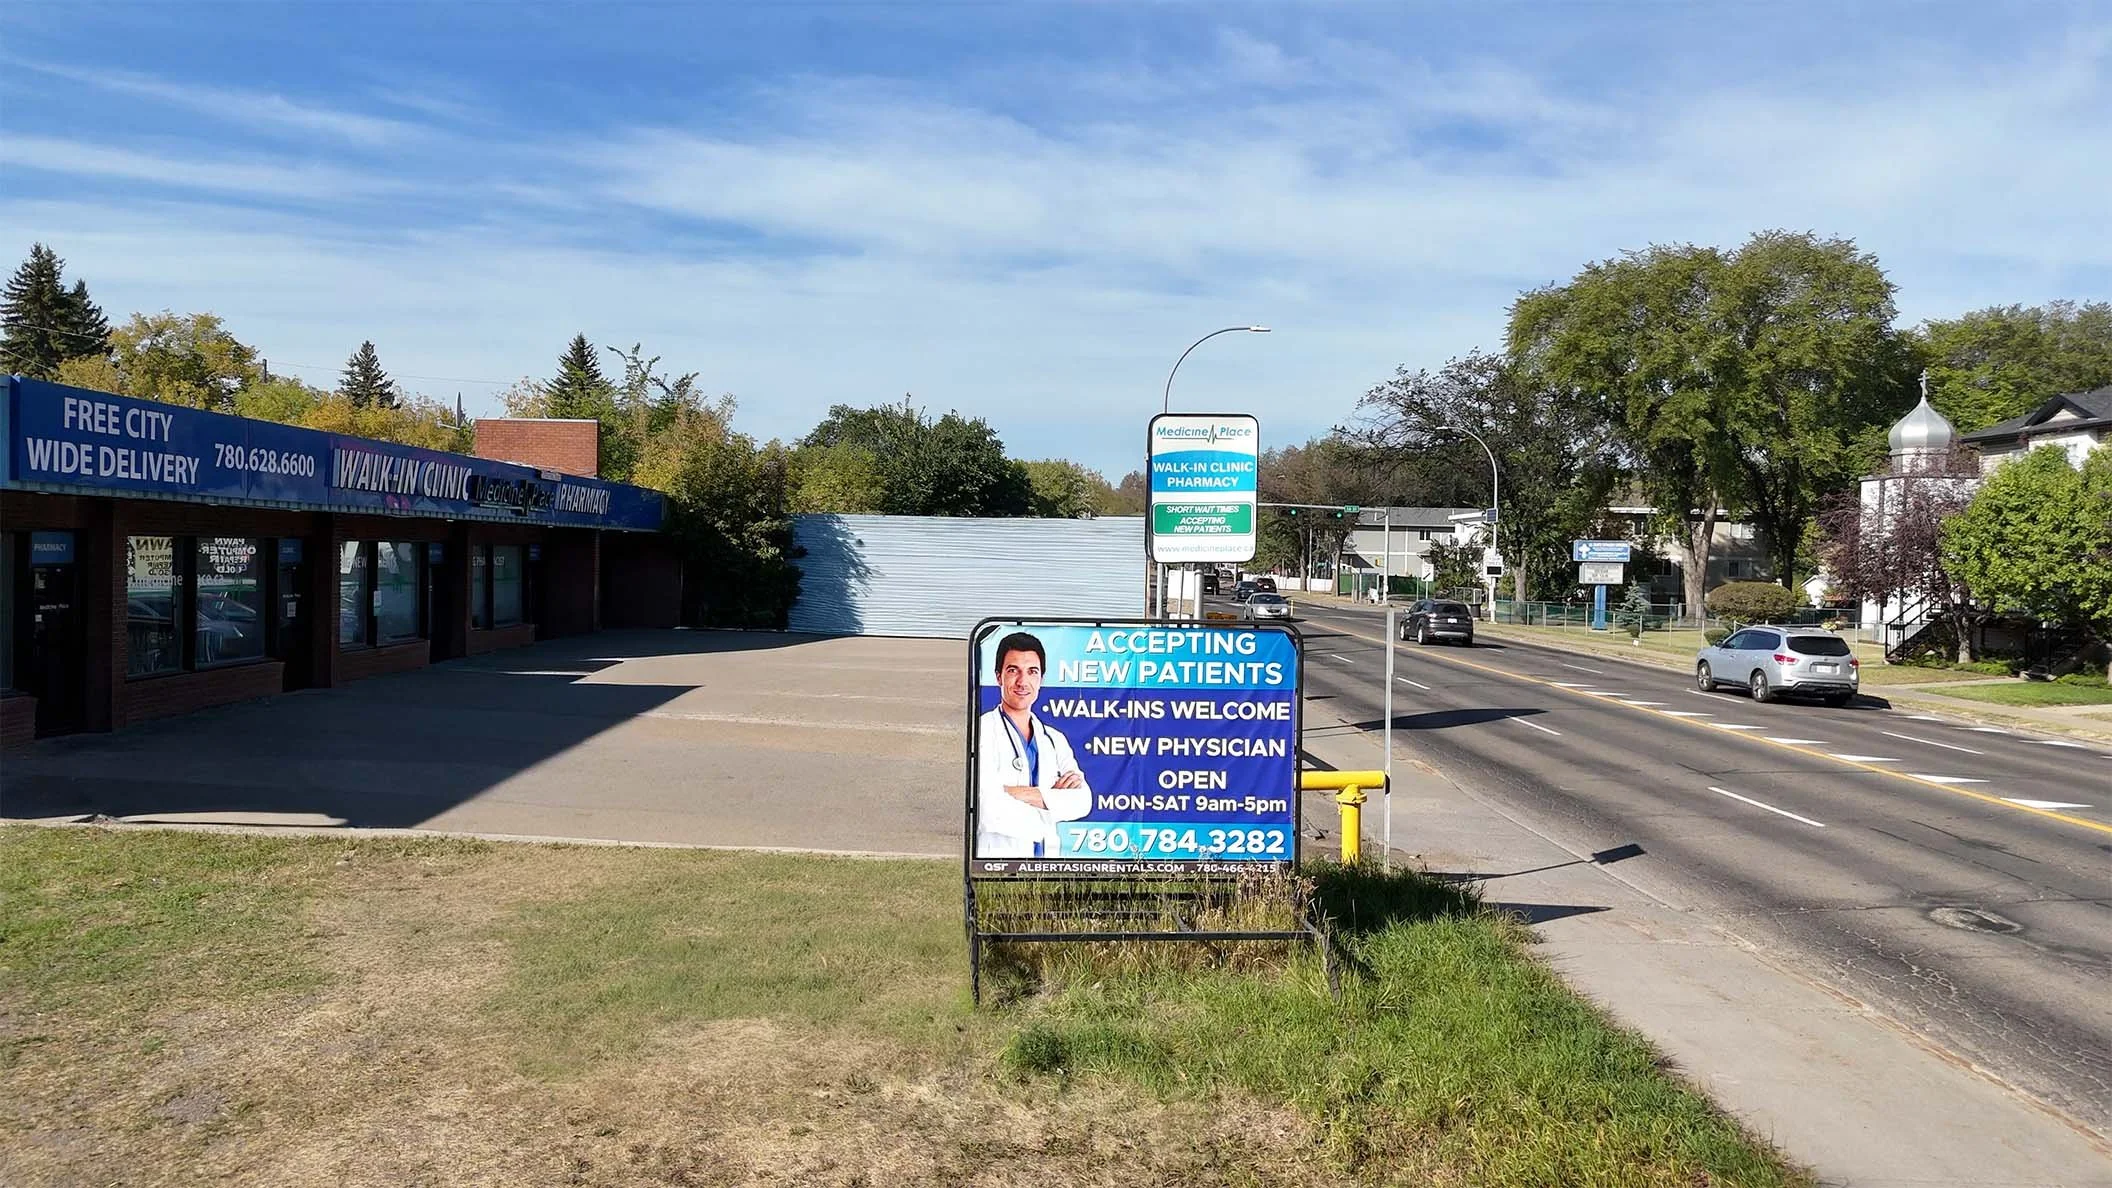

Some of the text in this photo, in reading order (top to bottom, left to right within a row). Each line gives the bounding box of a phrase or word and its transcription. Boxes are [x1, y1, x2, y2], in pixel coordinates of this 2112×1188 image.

[64, 397, 173, 442] FREE CITY
[1156, 426, 1252, 437] Medicine Place
[27, 437, 200, 485] WIDE DELIVERY
[214, 443, 315, 477] 780.628.6600
[1153, 461, 1254, 473] WALK-IN CLINIC
[334, 448, 473, 501] WALK-IN CLINIC
[1167, 477, 1239, 488] PHARMACY
[475, 476, 524, 505] Medicine
[558, 483, 611, 514] PHARMACY
[1166, 505, 1240, 513] SHORT WAIT TIMES
[1173, 525, 1232, 533] NEW PATIENTS
[1179, 516, 1226, 525] ACCEPTING
[1085, 631, 1257, 656] ACCEPTING
[1058, 660, 1284, 686] NEW PATIENTS
[1171, 702, 1290, 721] WELCOME
[1156, 738, 1286, 758] PHYSICIAN
[1158, 770, 1227, 790] OPEN
[1097, 795, 1287, 816] MON-SAT 9am-5pm
[1069, 828, 1285, 854] 780.784.3282
[1018, 863, 1185, 873] ALBERTASIGNRENTALS.COM
